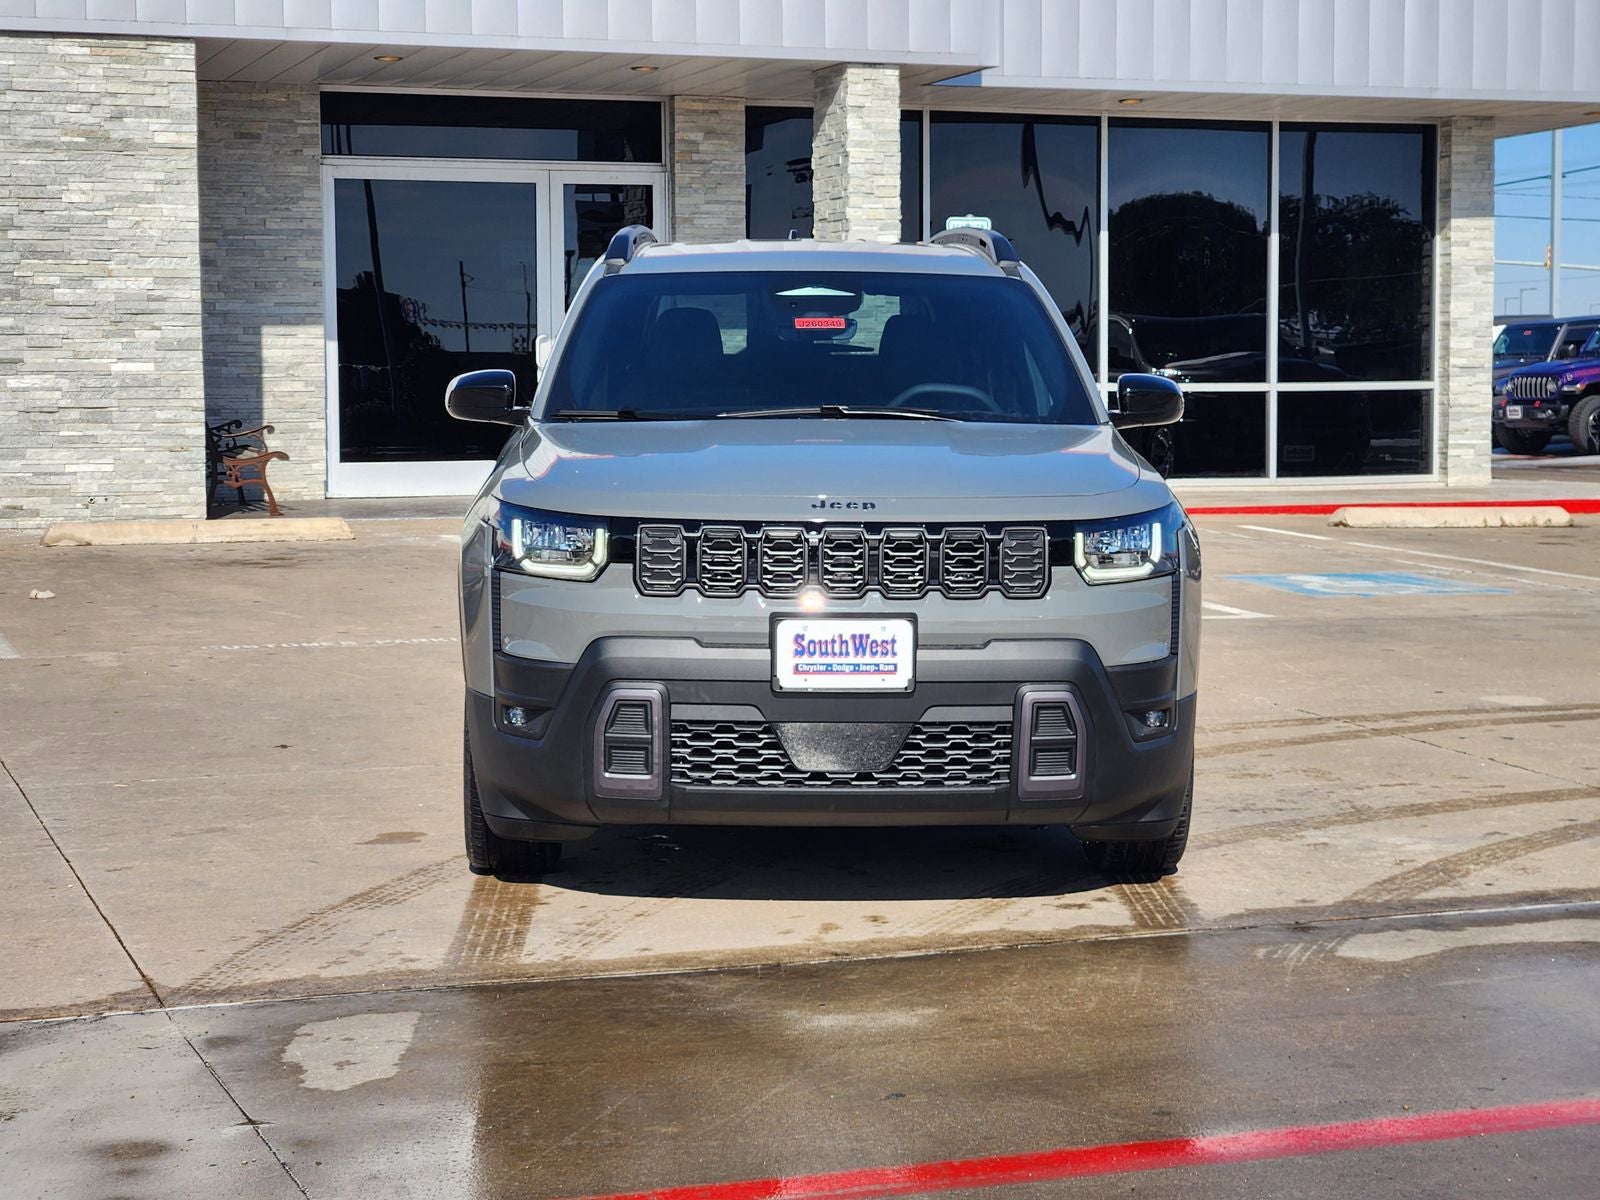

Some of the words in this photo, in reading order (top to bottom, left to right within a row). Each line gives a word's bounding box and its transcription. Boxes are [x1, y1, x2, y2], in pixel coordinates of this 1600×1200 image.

[811, 500, 876, 510] Jeep
[793, 633, 898, 658] SouthWest
[798, 663, 827, 673] Chrysler
[832, 663, 855, 673] Dodge
[859, 663, 875, 673] Jeep
[879, 663, 895, 672] Ram
